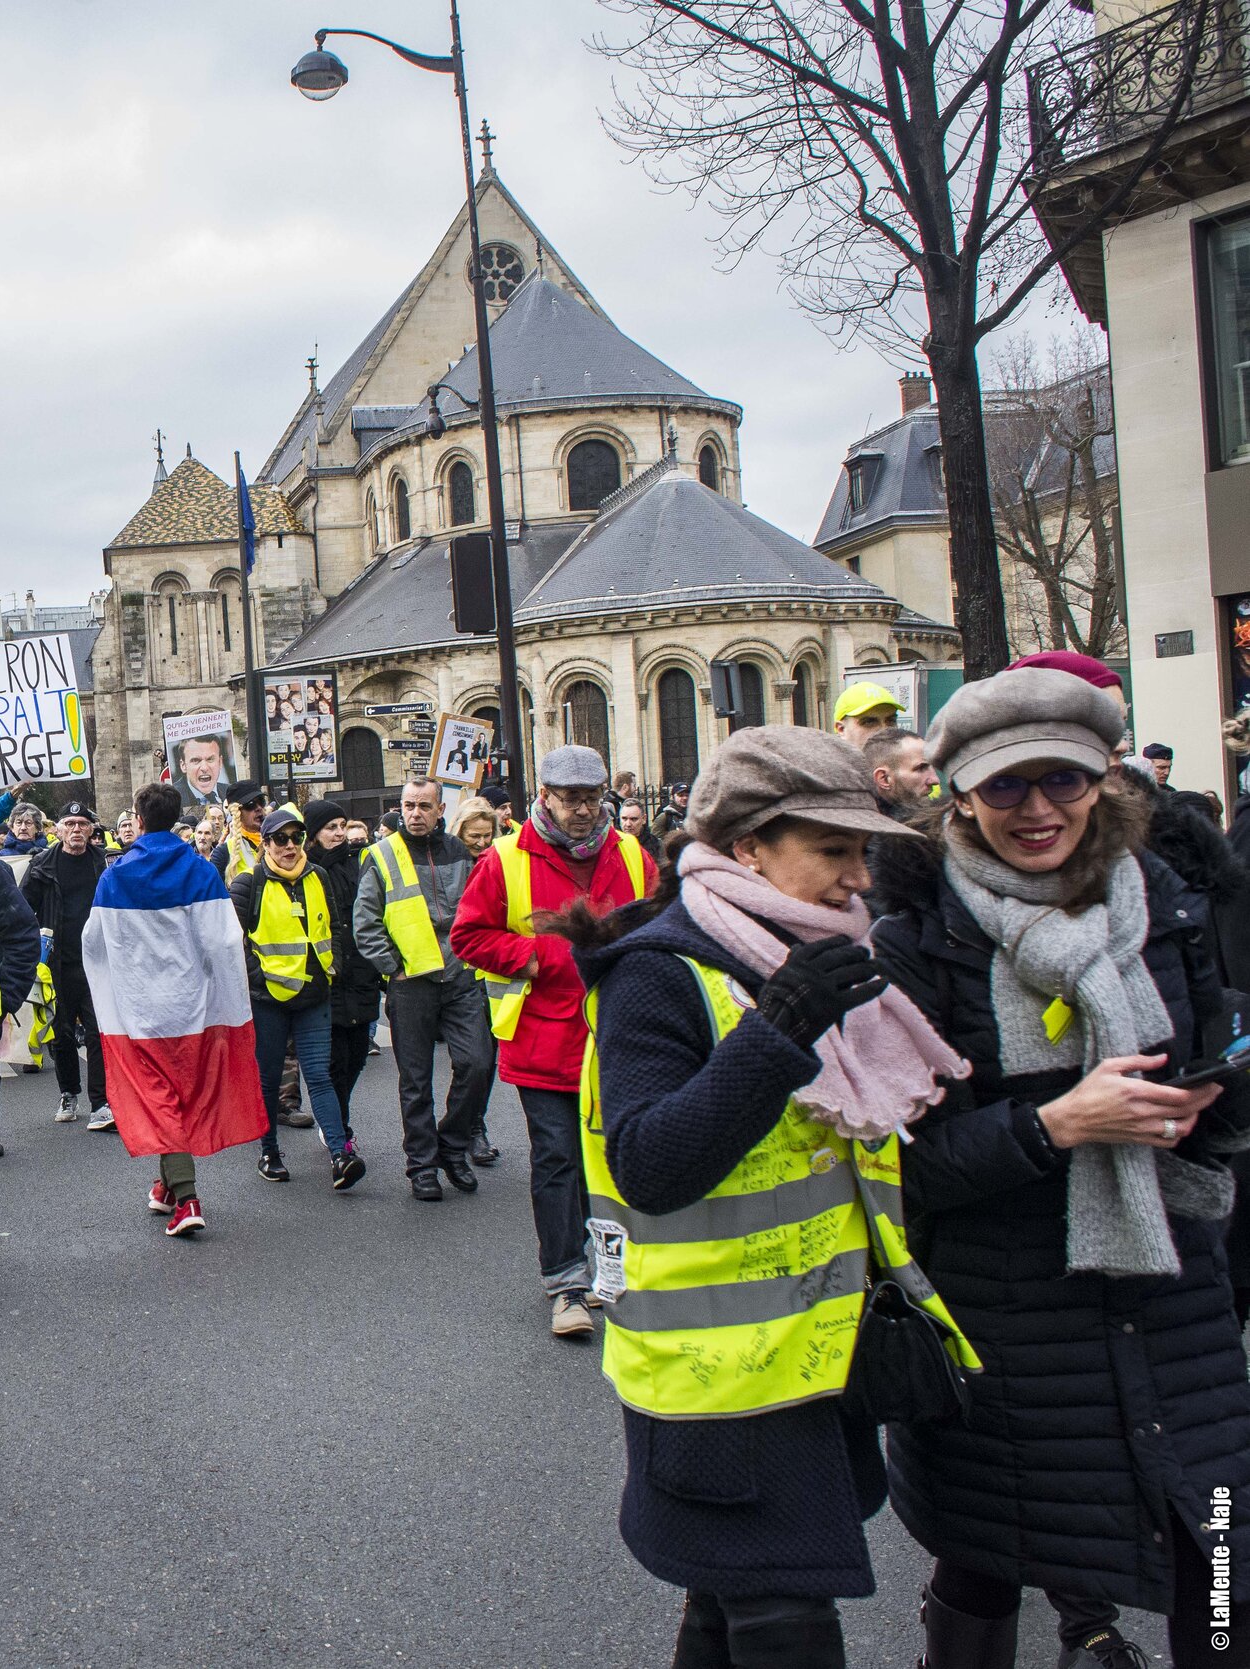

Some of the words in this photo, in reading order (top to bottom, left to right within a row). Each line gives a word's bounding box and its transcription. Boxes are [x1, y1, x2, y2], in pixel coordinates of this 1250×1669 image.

[190, 713, 228, 726] VIENNENT
[167, 730, 179, 738] ME
[181, 722, 222, 736] CHERCHER
